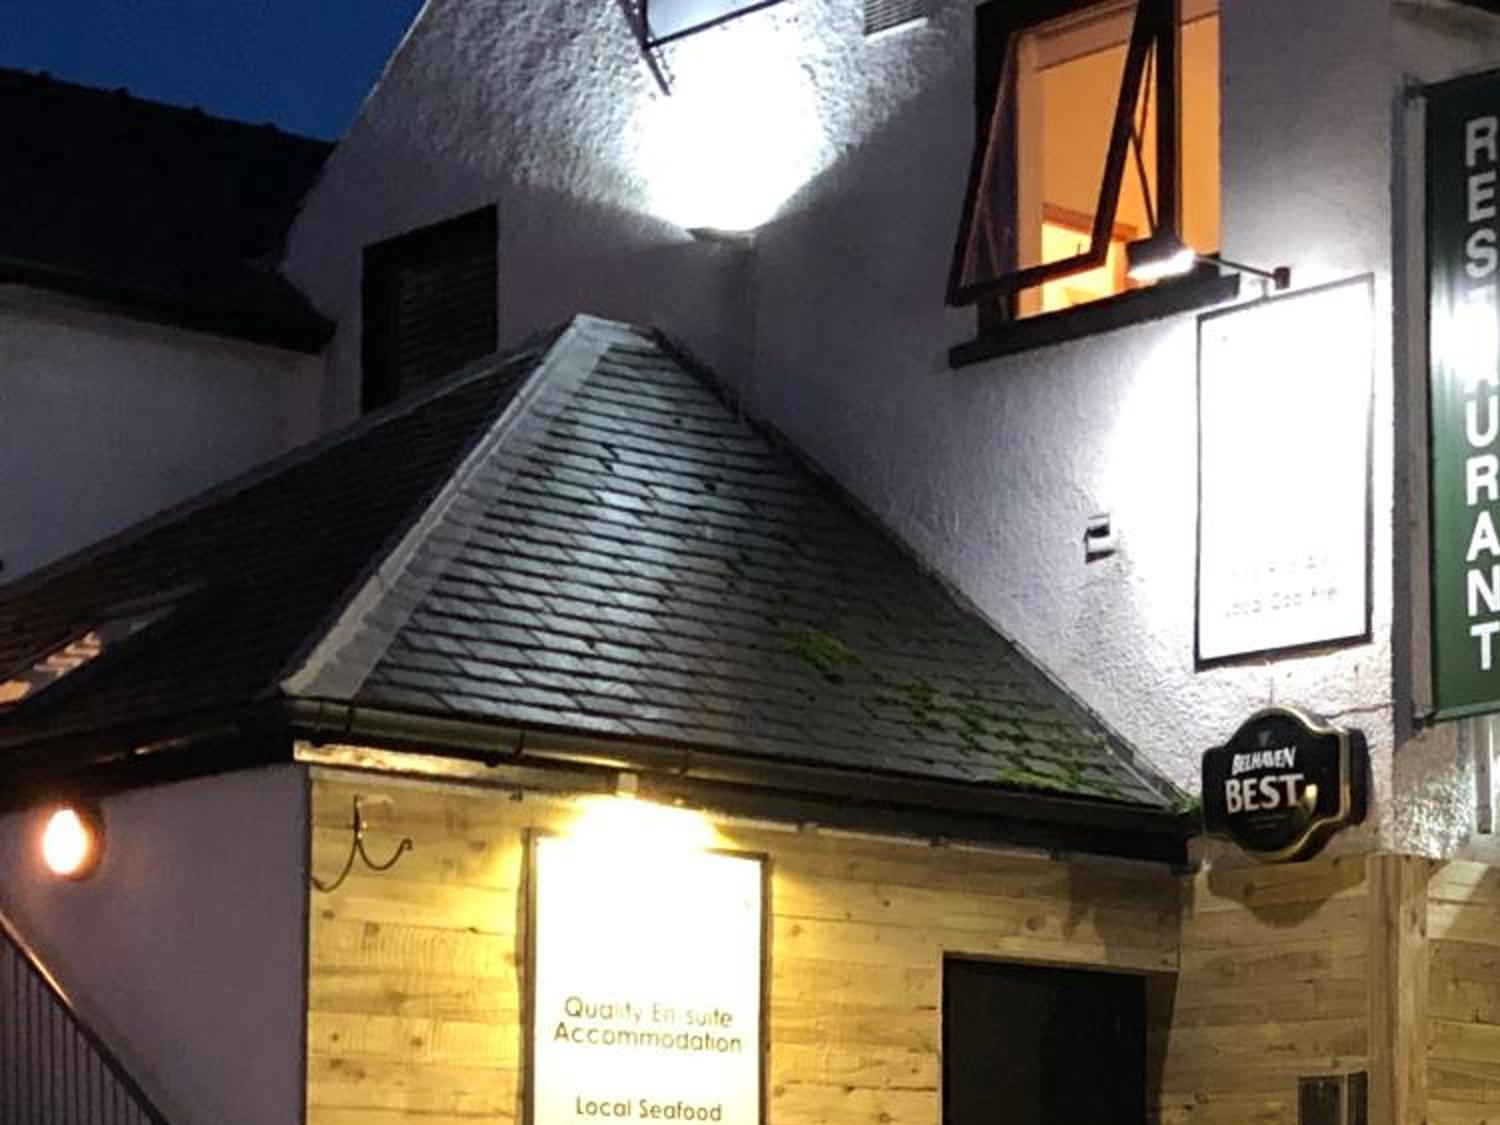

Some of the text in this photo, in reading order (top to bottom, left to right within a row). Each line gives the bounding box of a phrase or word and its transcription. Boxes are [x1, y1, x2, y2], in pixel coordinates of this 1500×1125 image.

[1231, 745, 1297, 777] BELHAVEN
[1224, 773, 1305, 815] BEST
[564, 995, 643, 1025] Quality
[553, 1020, 743, 1054] Accommodation
[576, 1096, 722, 1123] Local Seafood
